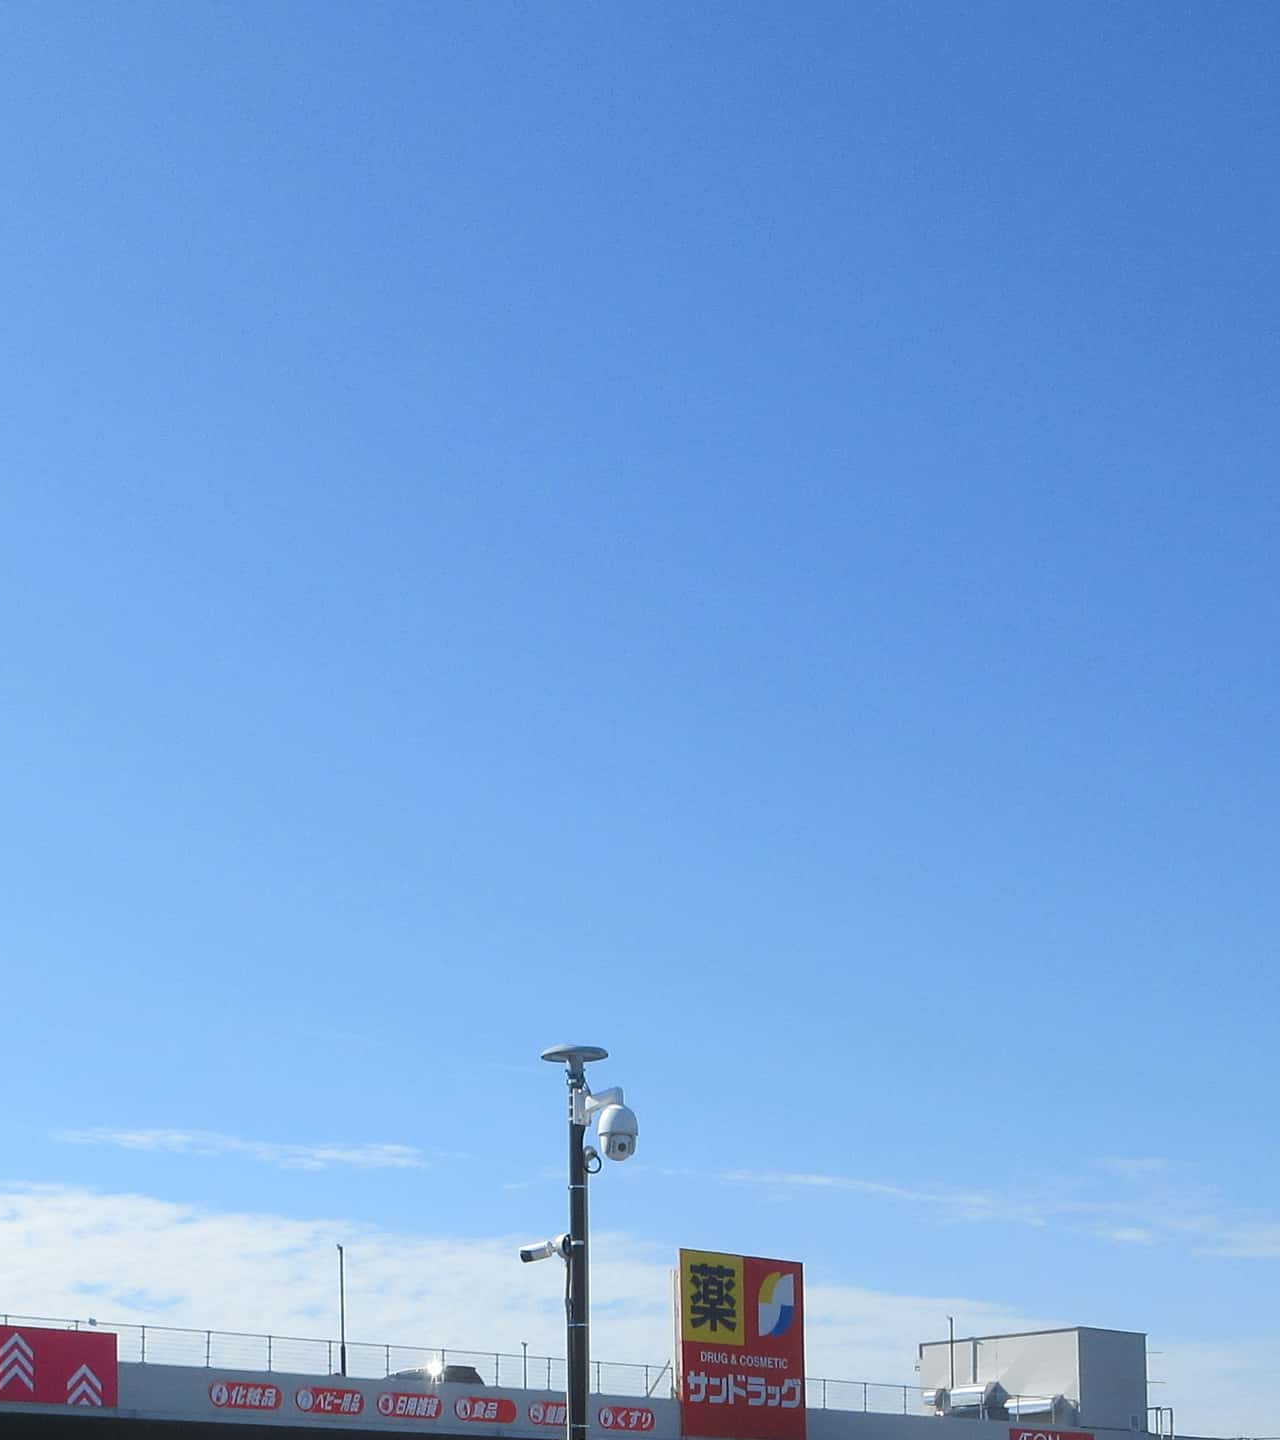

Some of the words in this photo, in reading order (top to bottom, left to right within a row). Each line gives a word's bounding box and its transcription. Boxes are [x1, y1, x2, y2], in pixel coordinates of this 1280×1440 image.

[690, 1263, 737, 1332] 薬
[700, 1351, 728, 1364] DRUG
[730, 1354, 737, 1365] &
[739, 1354, 788, 1369] COSMETIC
[230, 1385, 277, 1408] 化粧品
[687, 1370, 801, 1408] サンドラッグ
[315, 1390, 361, 1413] ベビー用品
[471, 1402, 498, 1419] 食品
[616, 1409, 653, 1428] くすり
